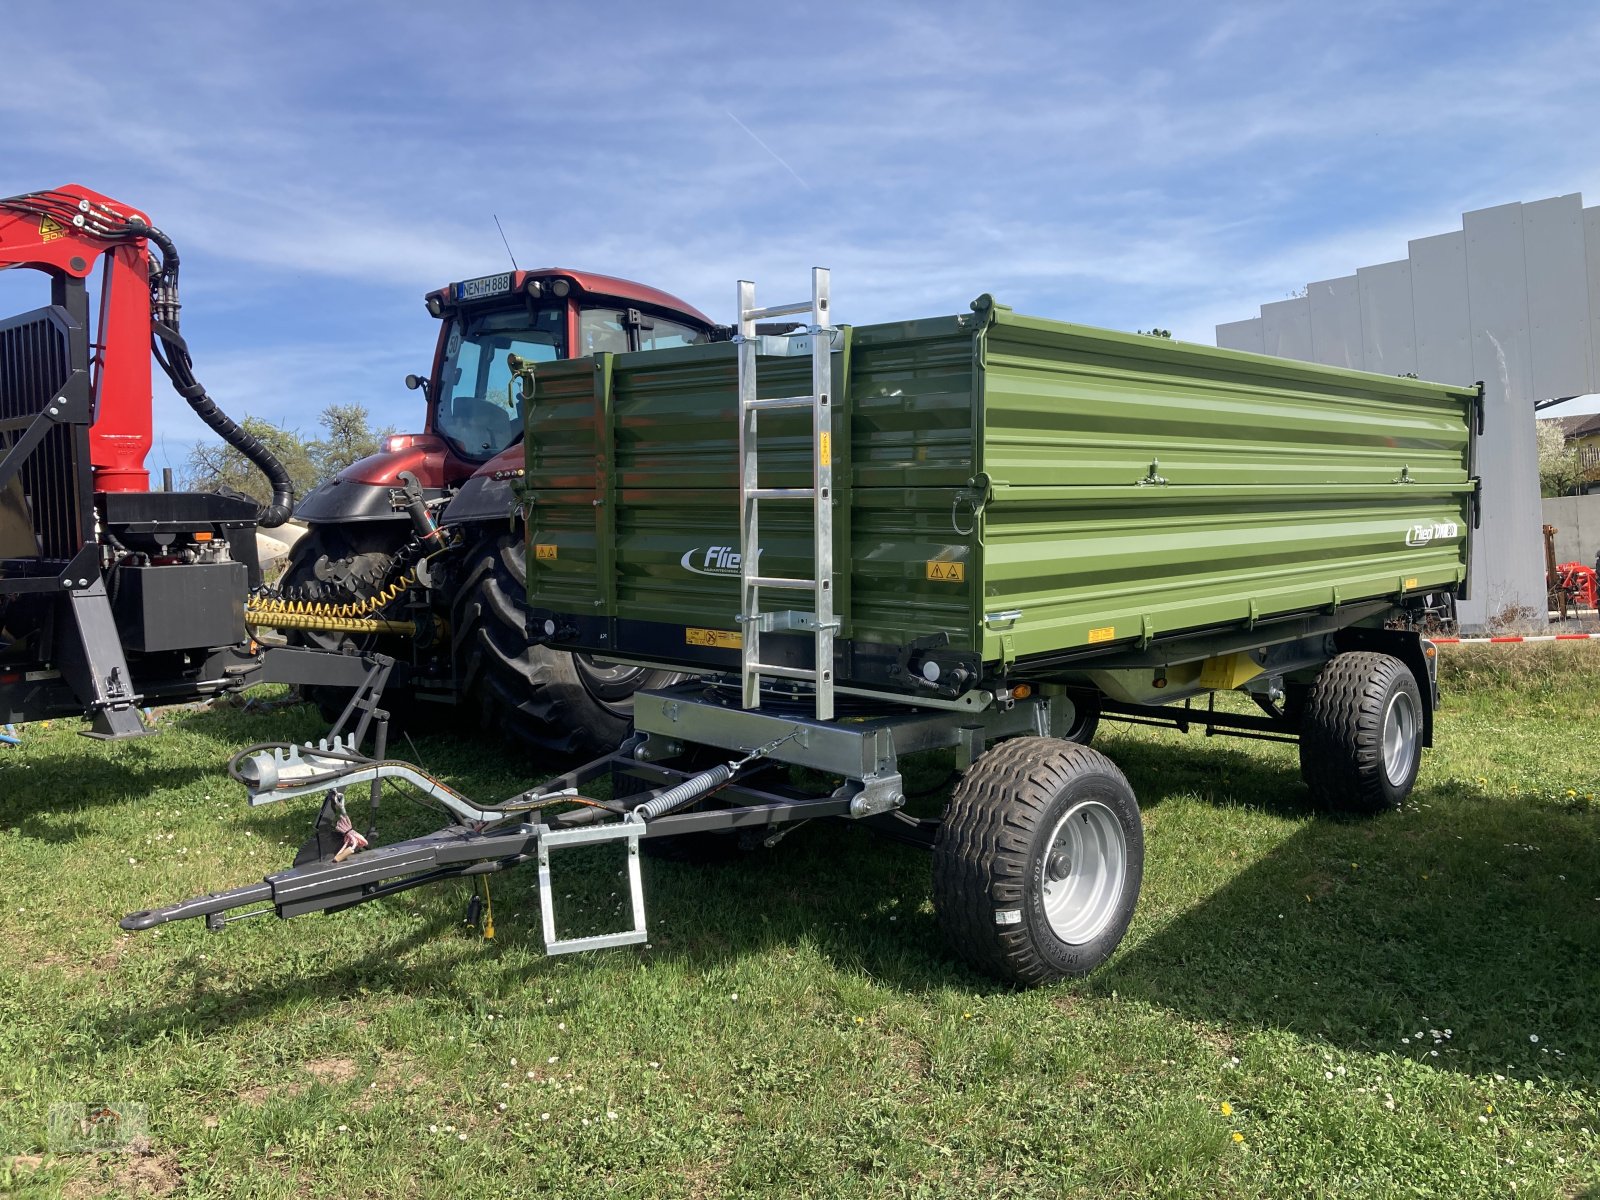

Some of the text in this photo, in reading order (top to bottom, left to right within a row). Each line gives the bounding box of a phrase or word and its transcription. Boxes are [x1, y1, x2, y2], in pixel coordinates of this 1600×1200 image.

[464, 281, 480, 297] NEN
[485, 279, 490, 292] H
[492, 275, 508, 291] 888
[704, 546, 763, 569] Flie
